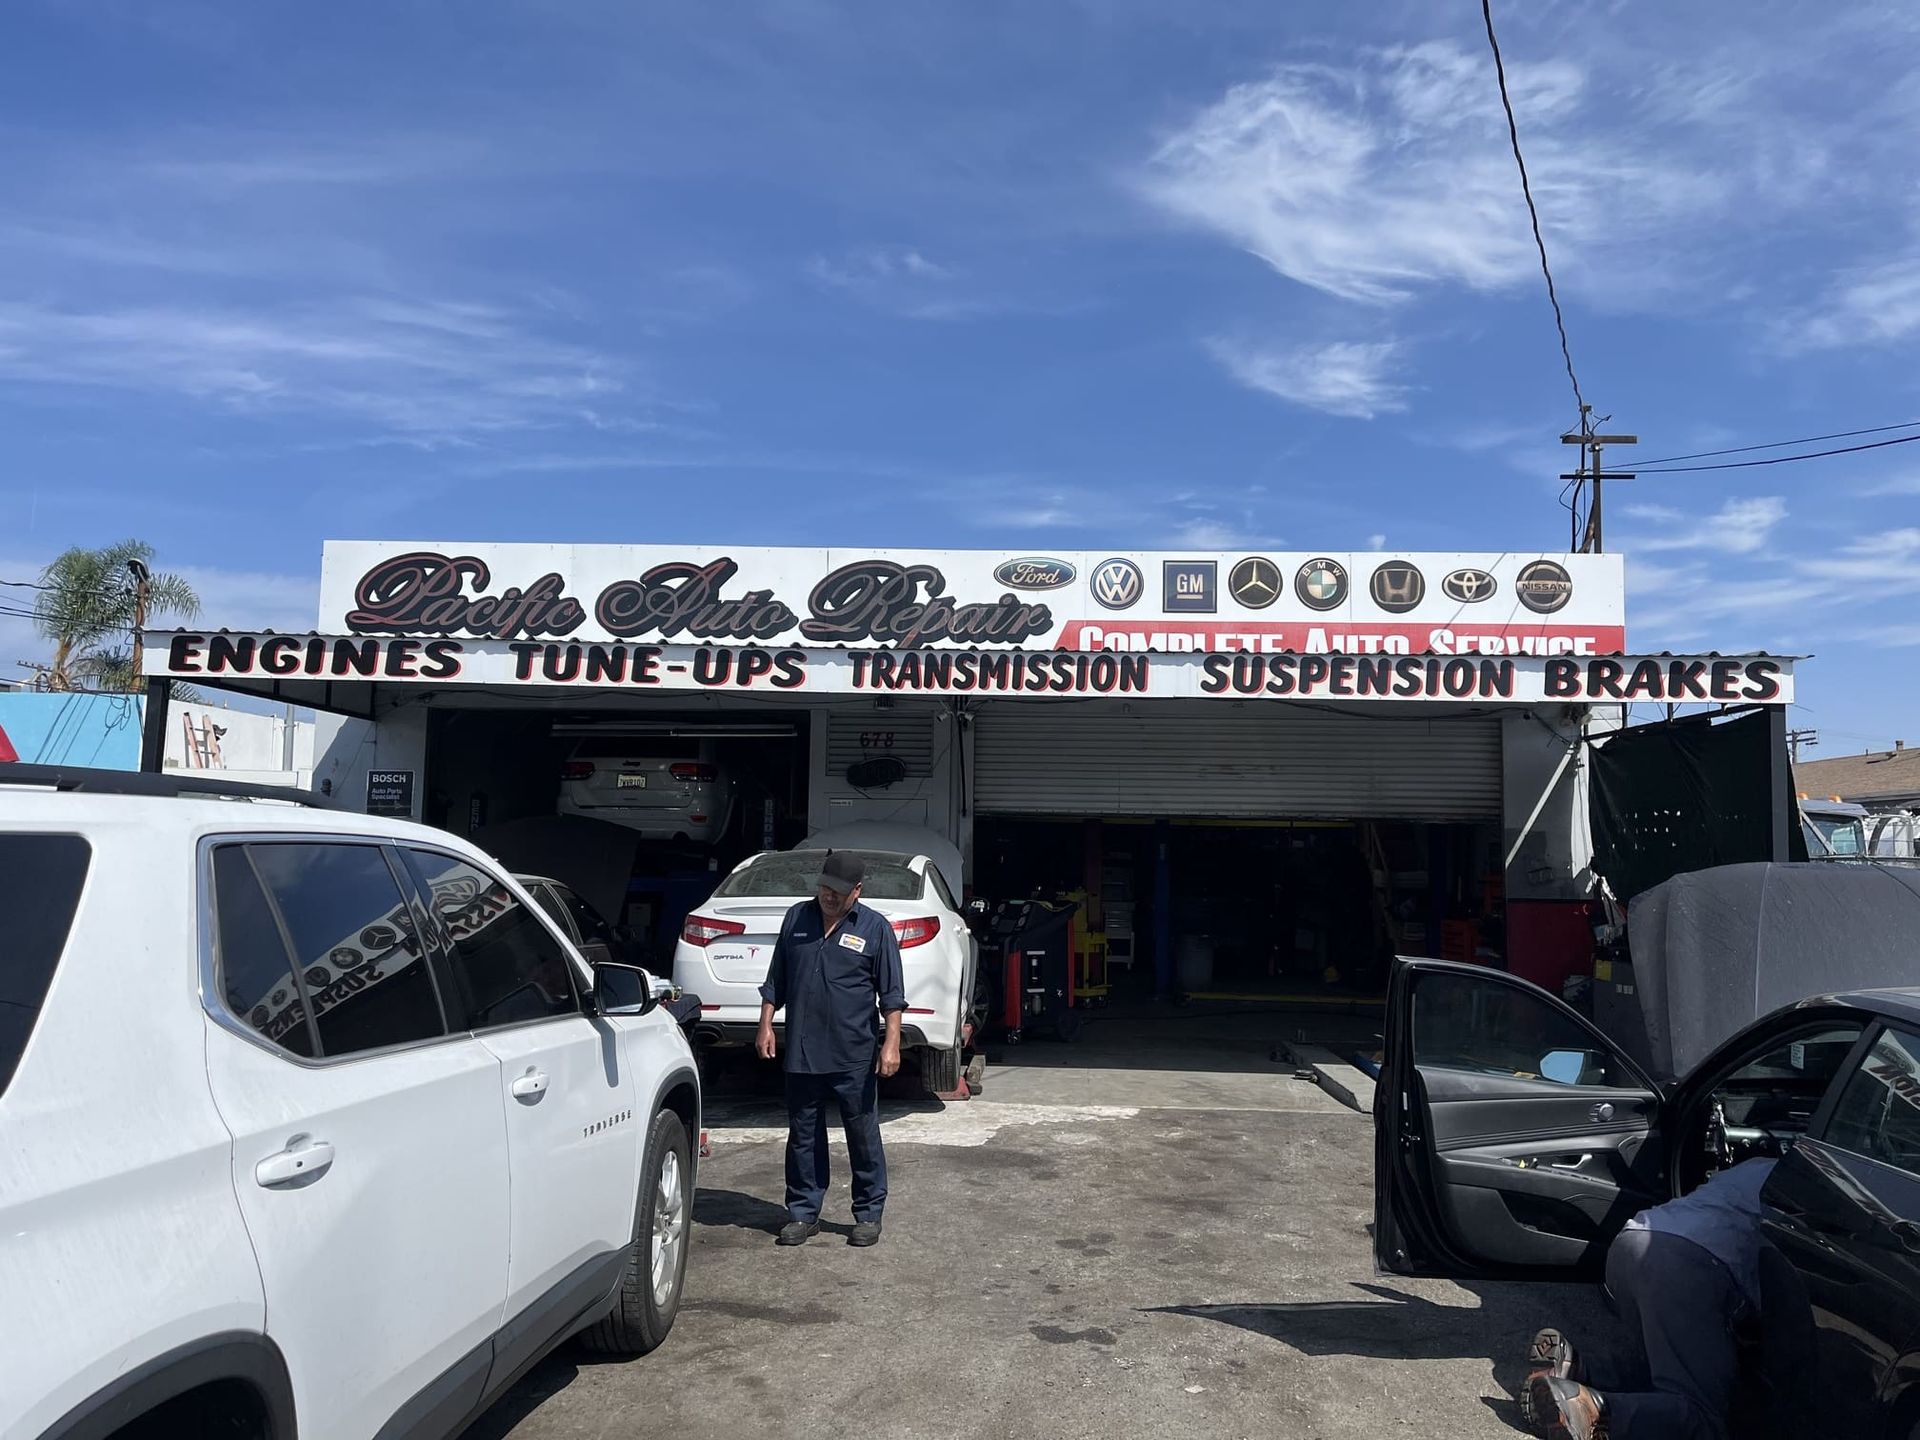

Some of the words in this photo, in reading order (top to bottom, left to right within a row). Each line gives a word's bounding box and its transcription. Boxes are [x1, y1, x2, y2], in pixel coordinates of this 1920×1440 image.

[1011, 563, 1060, 584] Ford
[1176, 573, 1203, 593] GM
[1302, 561, 1341, 577] BMW
[345, 552, 586, 638] Pacific
[595, 557, 799, 638] Auto
[799, 560, 1053, 649] Repair
[168, 635, 463, 679] ENGINES
[509, 643, 807, 687] TUNE-UPS
[847, 651, 1148, 691] TRANSMISSION
[1200, 655, 1514, 698] SUSPENSION
[1544, 659, 1780, 699] BRAKES
[860, 732, 895, 747] 678
[372, 774, 406, 783] BOSCH
[583, 1109, 631, 1138] TRAVERSE
